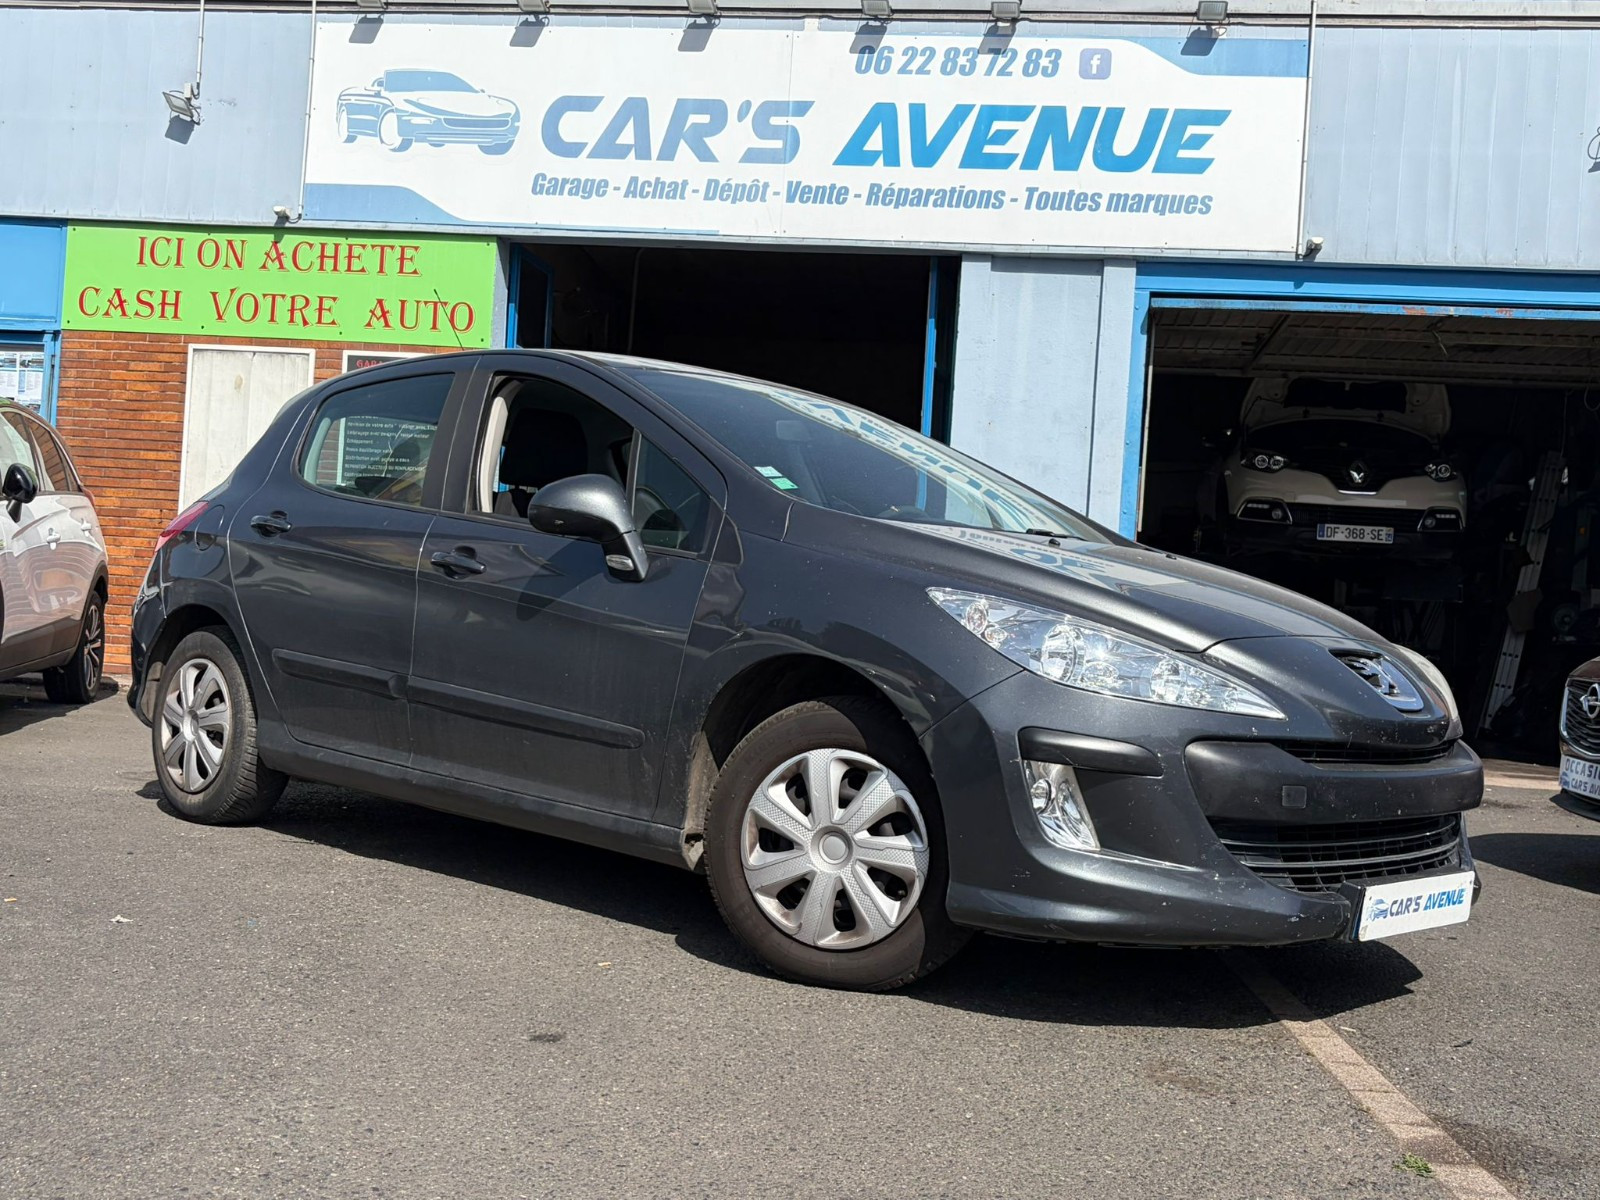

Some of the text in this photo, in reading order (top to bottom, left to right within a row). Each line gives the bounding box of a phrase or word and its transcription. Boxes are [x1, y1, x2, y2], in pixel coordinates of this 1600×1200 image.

[855, 45, 1062, 78] 06 22 83 72 83
[541, 95, 1232, 175] CAR'S AVENUE
[531, 173, 609, 200] Garage
[624, 176, 689, 200] Achat
[703, 178, 771, 205] Dépôt
[785, 181, 849, 206] Vente
[867, 182, 1005, 210] Réparations
[1024, 187, 1101, 212] Toutes
[1105, 193, 1213, 216] marques
[136, 235, 422, 276] ICI ON ACHETE
[78, 286, 476, 333] CASH VOTRE AUTO
[1326, 526, 1385, 541] DF-368-SE
[1389, 888, 1465, 917] CAR'S AVENUE
